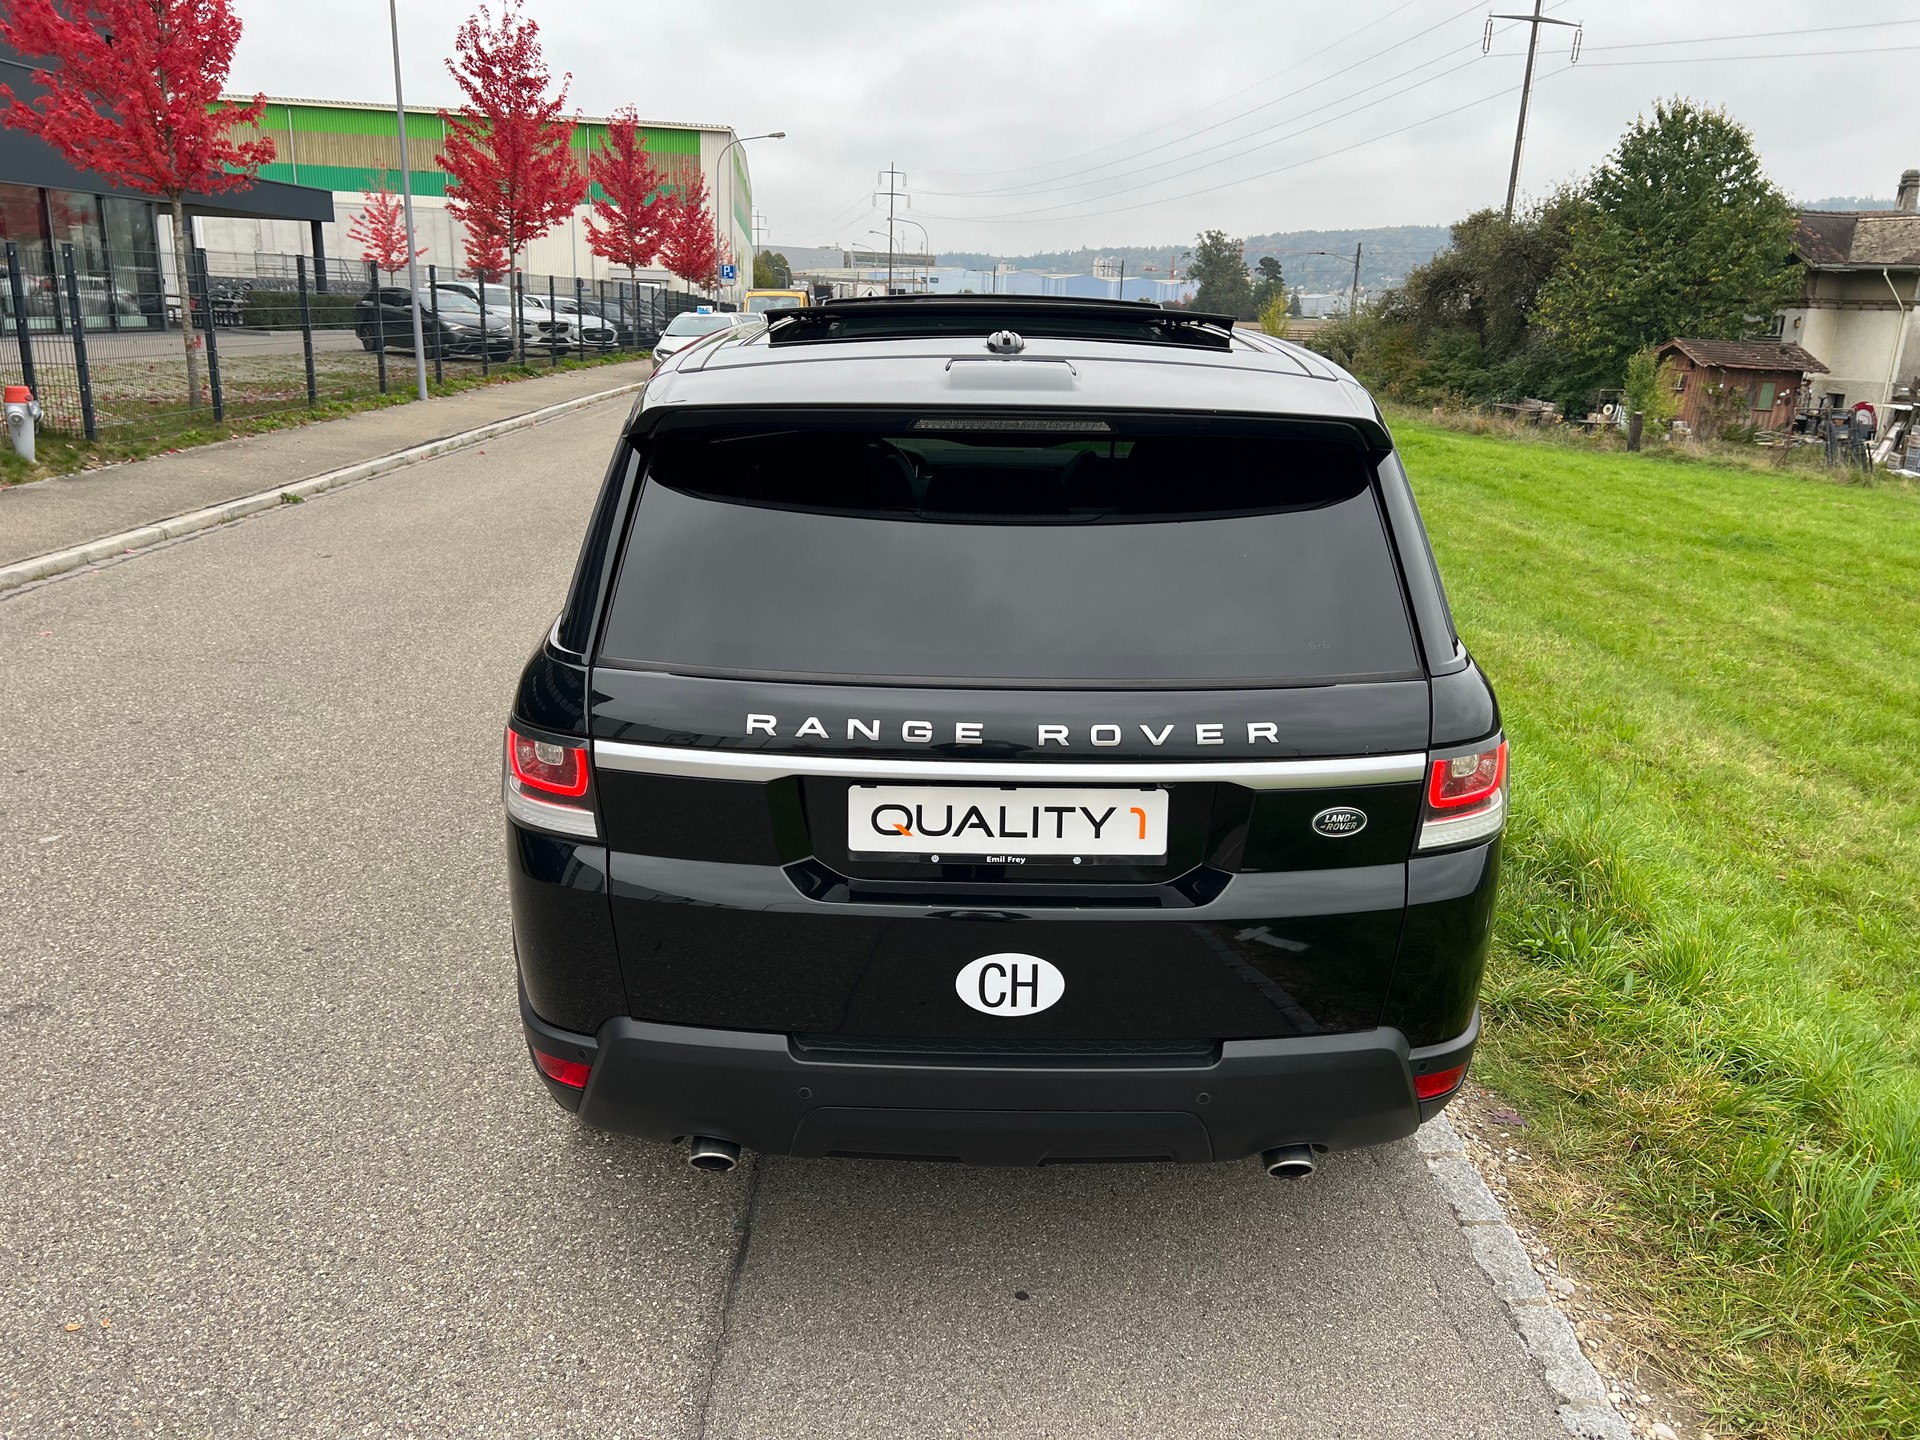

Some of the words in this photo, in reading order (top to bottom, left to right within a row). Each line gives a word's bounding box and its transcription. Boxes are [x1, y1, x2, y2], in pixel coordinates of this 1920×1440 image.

[746, 713, 984, 744] RANGE
[1037, 722, 1279, 746] ROVER
[871, 803, 1117, 839] QUALITY
[1130, 807, 1146, 839] 1
[986, 855, 1005, 863] Emil
[1007, 856, 1026, 865] Frey
[978, 962, 1038, 1008] CH
